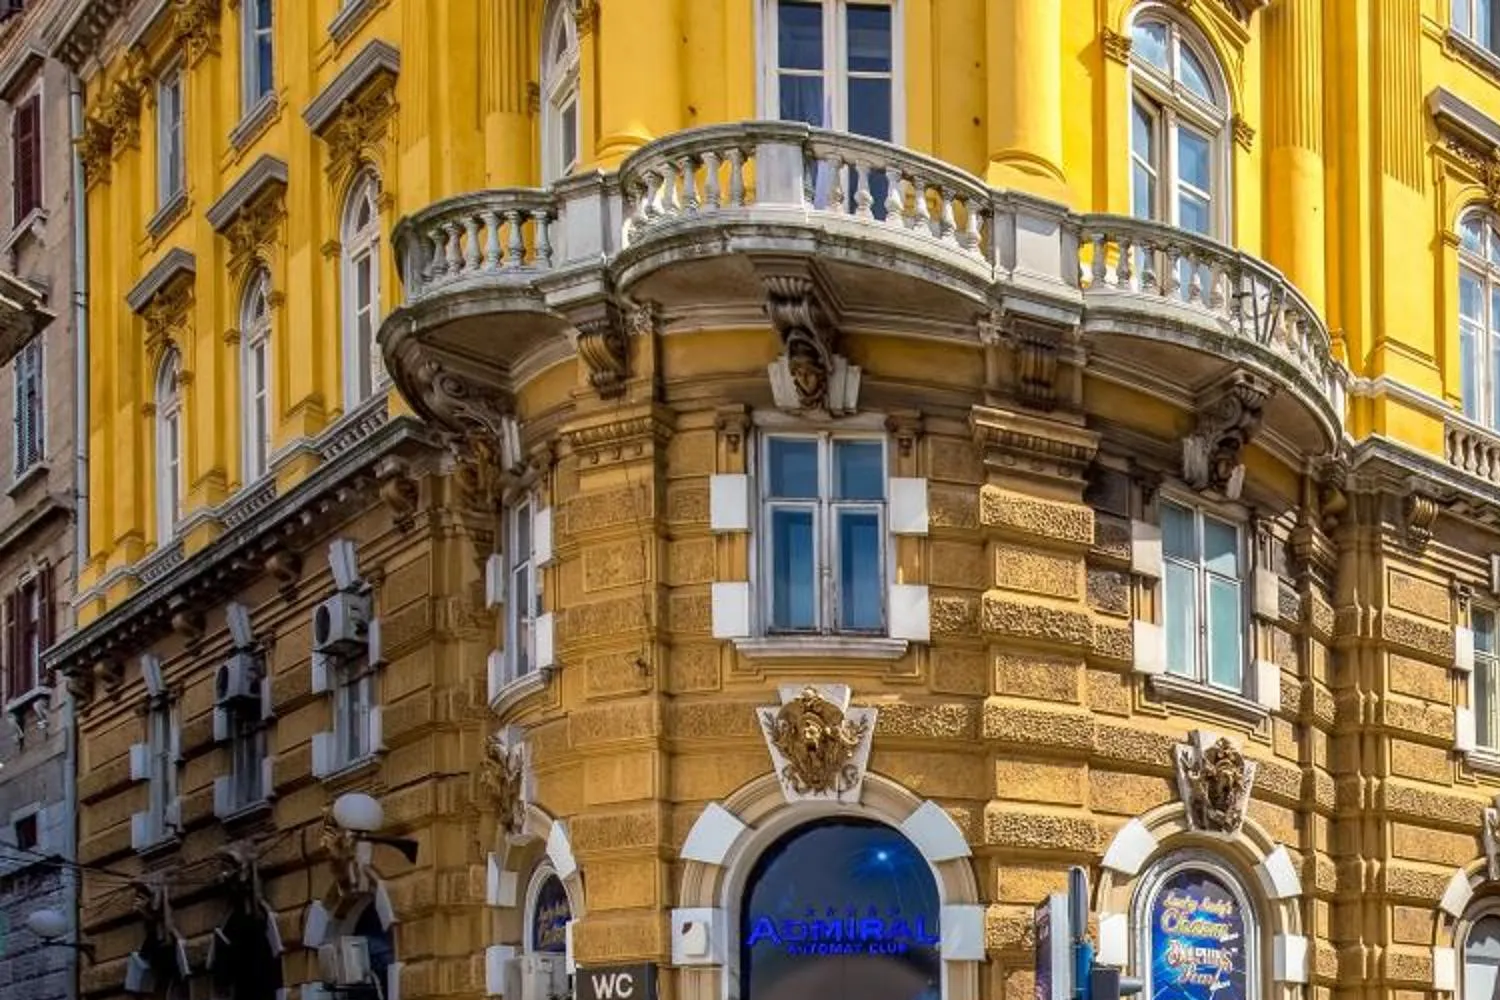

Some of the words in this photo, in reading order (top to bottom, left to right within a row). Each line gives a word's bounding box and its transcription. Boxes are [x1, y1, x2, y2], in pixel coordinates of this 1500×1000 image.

[747, 914, 942, 946] ADMIRAL
[868, 941, 908, 955] CLUB
[591, 972, 634, 1000] WC
